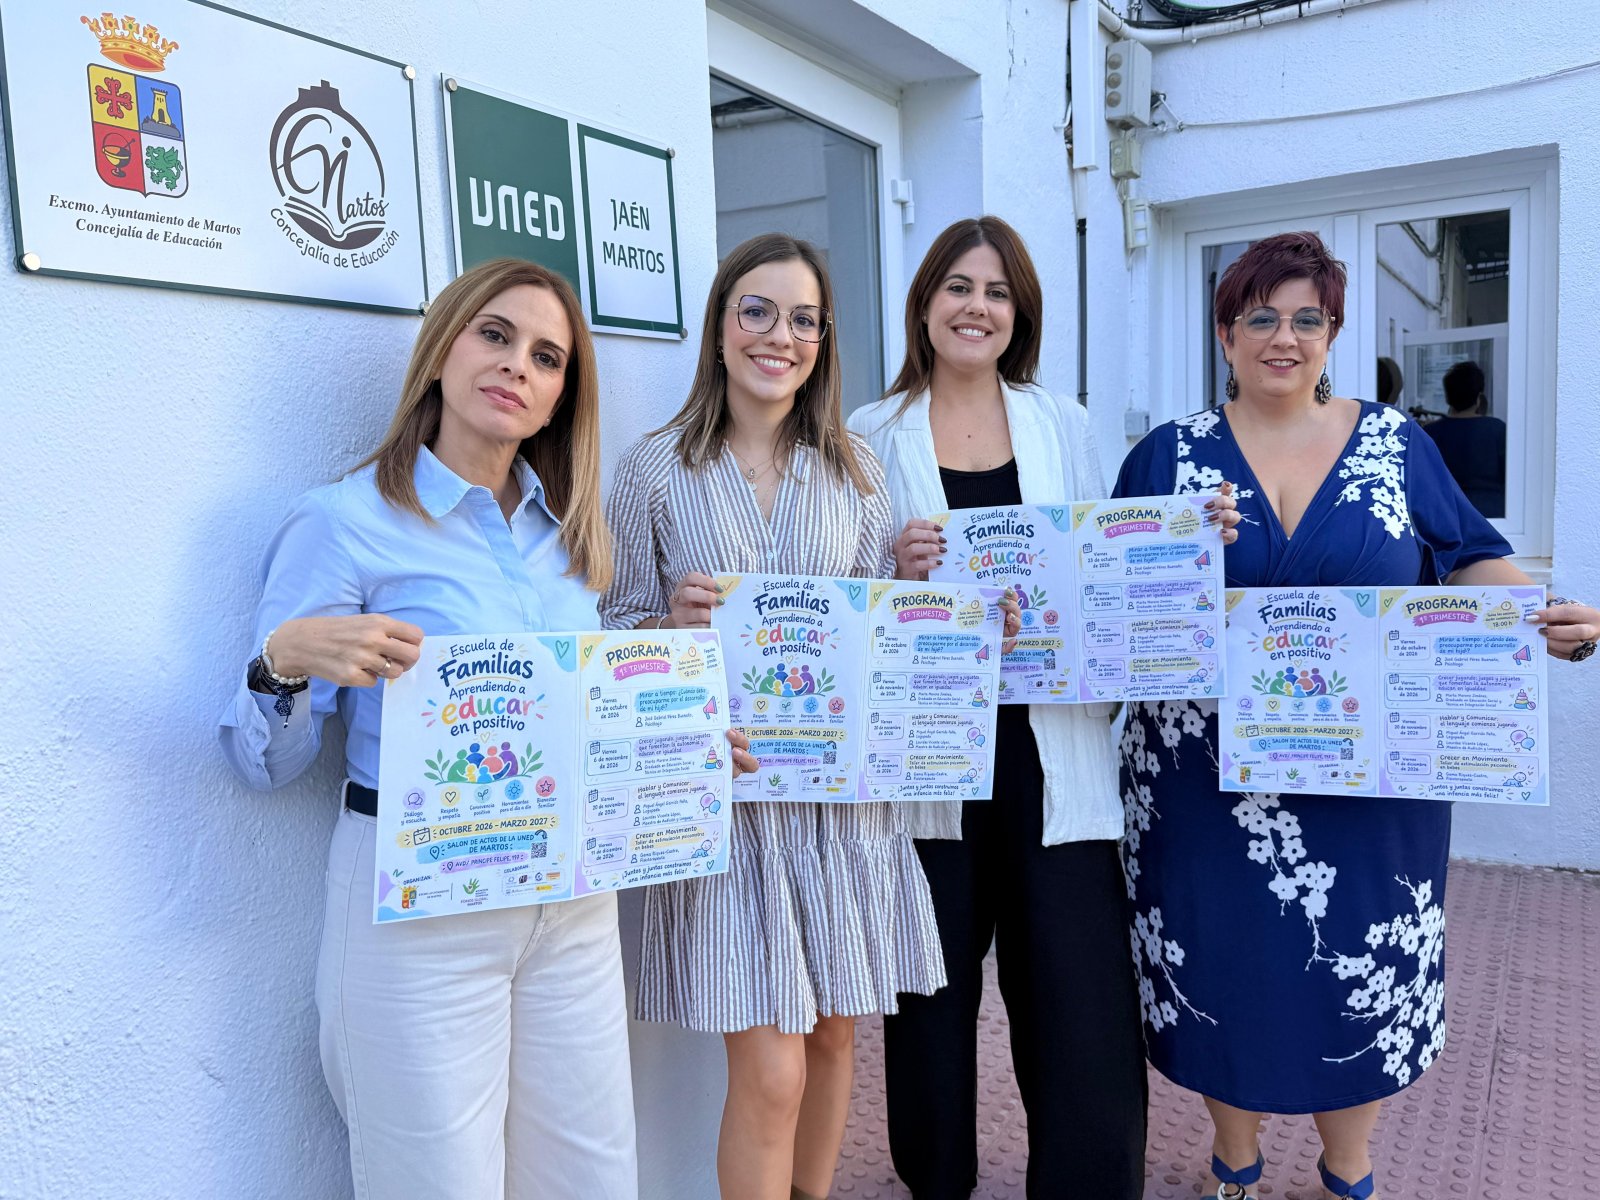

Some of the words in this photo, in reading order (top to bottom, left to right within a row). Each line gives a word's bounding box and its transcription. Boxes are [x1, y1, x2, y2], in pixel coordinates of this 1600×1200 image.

[49, 194, 99, 213] Excmo.
[101, 203, 184, 226] Ayuntamiento
[188, 216, 200, 229] de
[203, 219, 241, 235] Martos
[469, 177, 566, 241] UNED
[611, 199, 650, 231] JAÉN
[75, 218, 143, 239] Concejalía
[146, 229, 160, 241] de
[163, 231, 223, 250] Educación
[270, 208, 329, 264] Concejalía
[333, 253, 349, 268] de
[351, 230, 400, 269] Educación
[603, 241, 665, 274] MARTOS
[970, 509, 1004, 524] Escuela
[1007, 509, 1019, 518] de
[1096, 509, 1162, 527] PROGRAMA
[963, 519, 1034, 545] Familias
[1120, 523, 1155, 533] TRIMESTRE
[973, 540, 1023, 554] Aprendiendo
[968, 550, 1038, 571] educar
[976, 569, 990, 580] en
[993, 565, 1032, 578] positivo
[763, 578, 800, 592] Escuela
[803, 580, 815, 591] de
[753, 591, 830, 616] Familias
[893, 594, 953, 610] PROGRAMA
[1267, 590, 1304, 604] Escuela
[1307, 591, 1320, 601] de
[1258, 601, 1337, 624] Familias
[1406, 598, 1478, 615] PROGRAMA
[762, 613, 815, 627] Aprendiendo
[1430, 613, 1471, 622] TRIMESTRE
[755, 624, 830, 646] educar
[1268, 621, 1323, 634] Aprendiendo
[450, 638, 496, 658] Escuela
[500, 638, 514, 651] de
[762, 645, 778, 657] en
[780, 643, 822, 658] positivo
[1263, 631, 1339, 652] educar
[606, 644, 671, 666] PROGRAMA
[1270, 651, 1286, 661] en
[1288, 648, 1332, 661] positivo
[437, 652, 534, 687] Familias
[630, 662, 666, 673] TRIMESTRE
[450, 681, 516, 700] Aprendiendo
[519, 686, 526, 695] a
[442, 695, 536, 725] educar
[450, 722, 470, 737] en
[473, 715, 526, 734] positivo
[439, 824, 473, 836] OCTUBRE
[475, 822, 494, 832] 2026
[500, 819, 528, 829] MARZO
[530, 817, 548, 828] 2027
[666, 826, 698, 836] Movimiento
[479, 836, 499, 845] ACTOS
[518, 834, 535, 842] UNED
[480, 844, 509, 853] MARTOS
[664, 861, 692, 870] construimos
